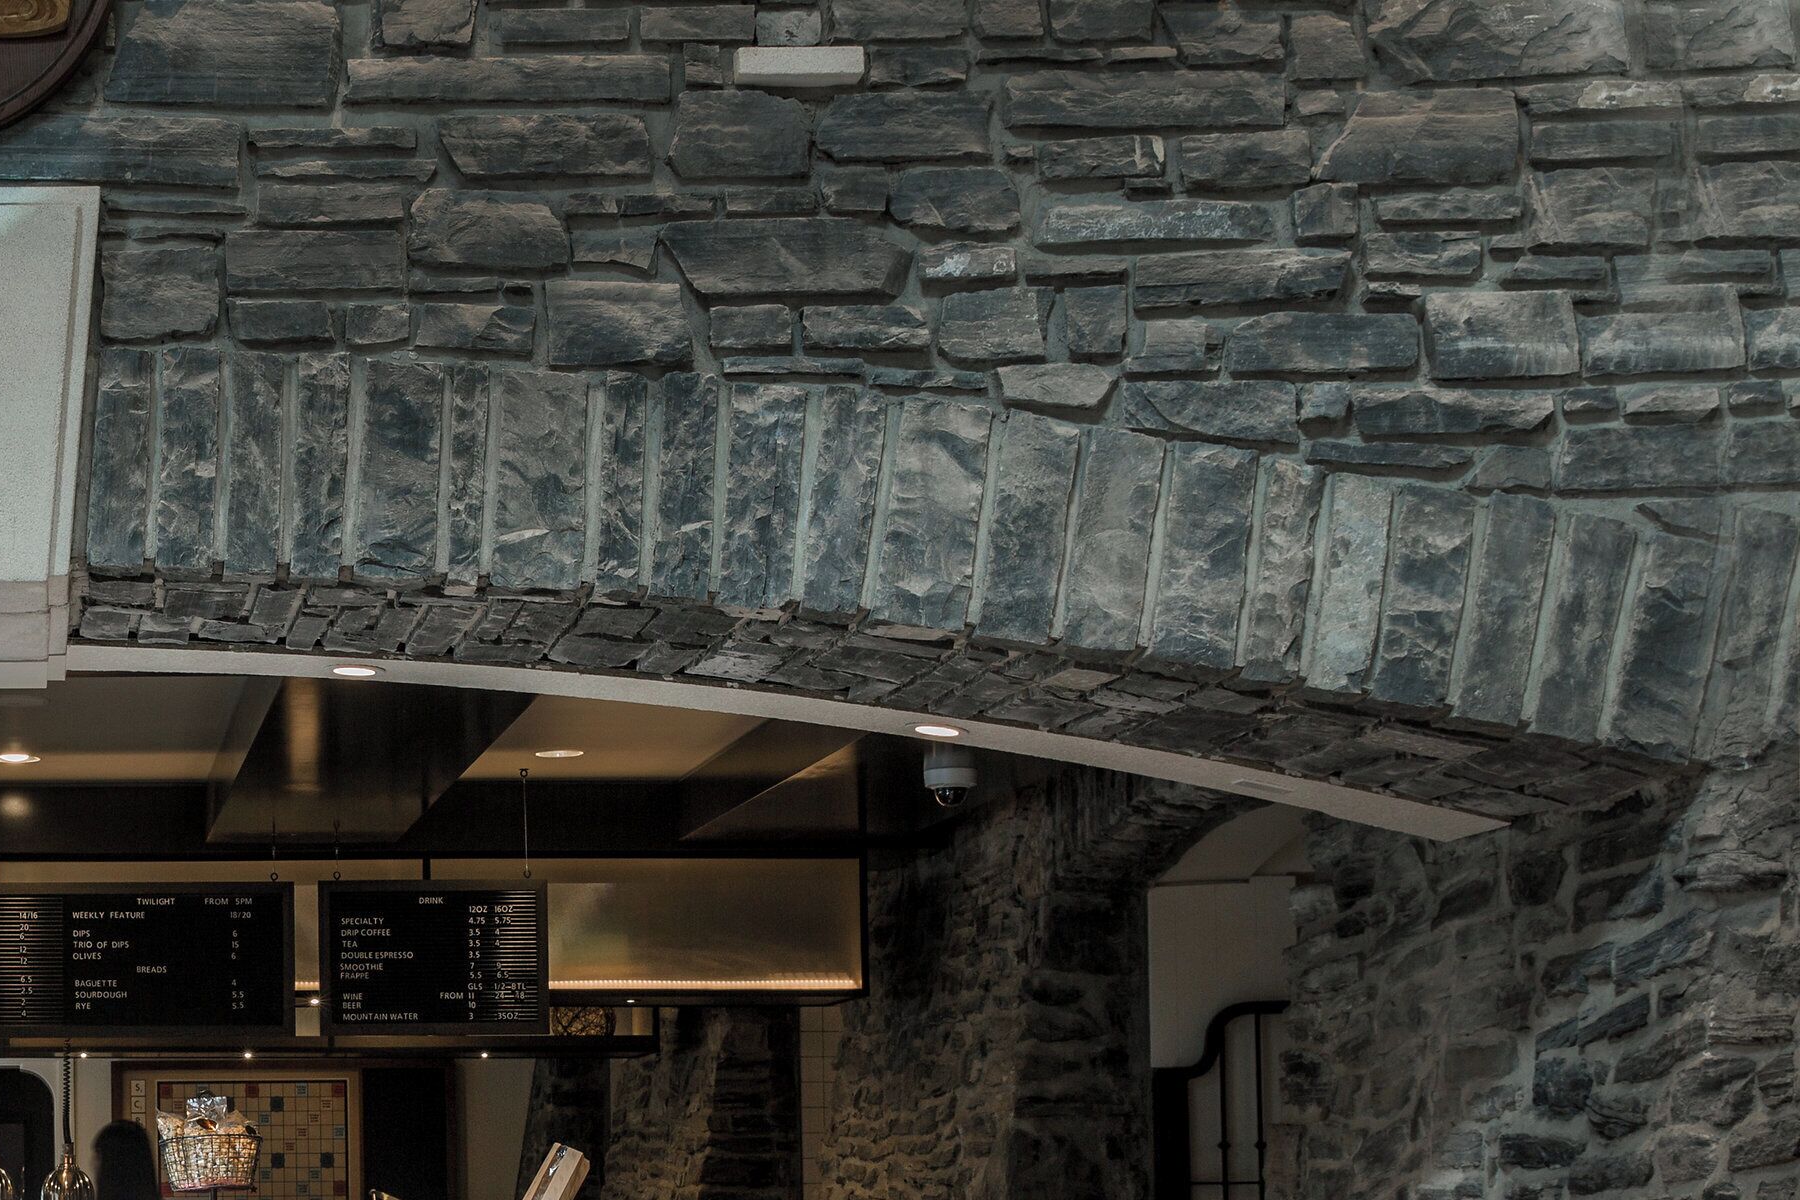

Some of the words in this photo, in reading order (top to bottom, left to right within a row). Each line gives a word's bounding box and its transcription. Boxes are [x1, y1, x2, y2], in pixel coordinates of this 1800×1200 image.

[136, 898, 176, 906] TWILIGHT
[204, 898, 229, 906] FROM
[235, 898, 253, 906] 5PM
[418, 897, 444, 905] DRINK
[72, 911, 105, 919] WEEKLY
[109, 911, 145, 919] FEATURE
[341, 917, 385, 926] SPECIALTY
[494, 916, 511, 924] 5.75
[72, 929, 91, 938] DIPS
[232, 930, 238, 938] 6
[341, 929, 359, 937] DRIP
[360, 928, 391, 937] COFFEE
[468, 928, 481, 936] 3.5
[494, 928, 500, 936] 4
[73, 940, 93, 949] TRIO
[96, 941, 108, 949] OF
[111, 940, 130, 949] DIPS
[231, 941, 240, 949] 15
[342, 940, 358, 948] TEA
[468, 939, 481, 947] 3.5
[494, 939, 500, 947] 4
[72, 952, 102, 960] OLIVES
[374, 951, 414, 959] ESPRESSO
[468, 951, 481, 959] 3.5
[136, 966, 167, 974] BREADS
[340, 963, 384, 971] SMOOTHIE
[496, 971, 509, 979] 6.5
[74, 980, 118, 988] BAGUETTE
[467, 983, 483, 991] GLS
[511, 983, 526, 991] BTL
[75, 991, 128, 999] SOURDOUGH
[232, 991, 244, 999] 5.5
[439, 992, 464, 1000] FROM
[75, 1002, 91, 1010] RYE
[232, 1002, 244, 1010] 5.5
[342, 1013, 388, 1021] MOUNTAIN
[469, 1012, 474, 1020] 3
